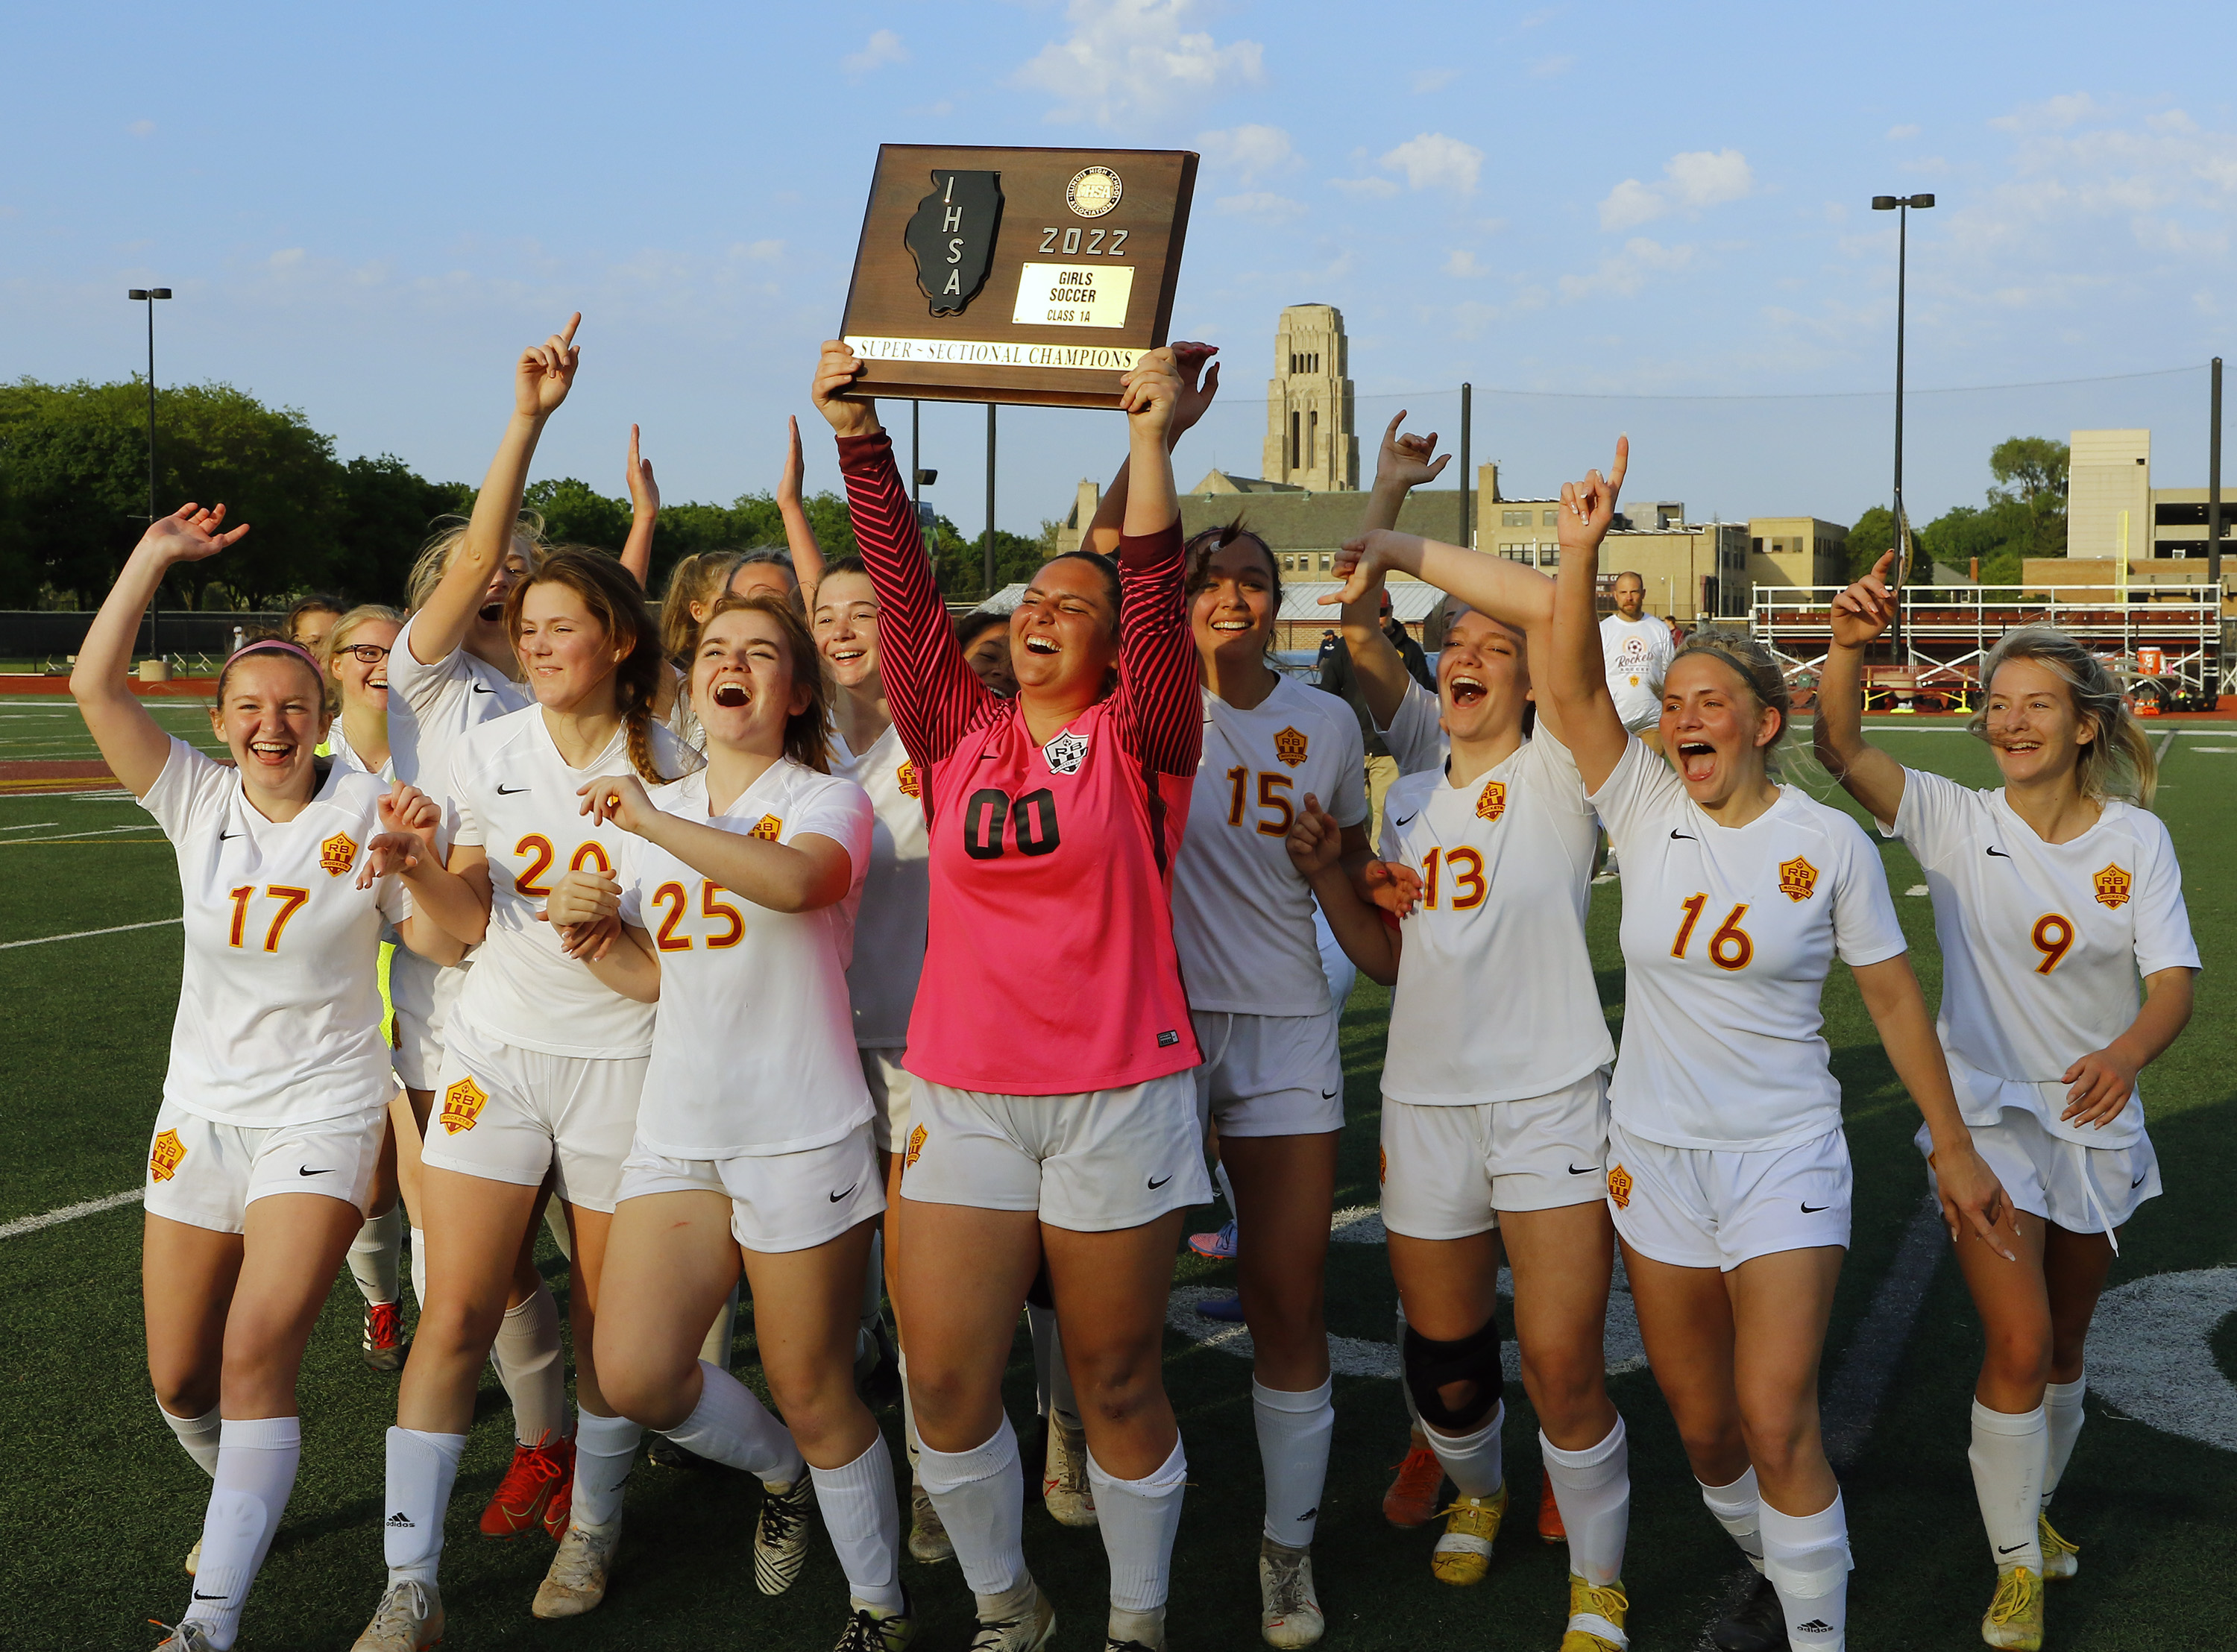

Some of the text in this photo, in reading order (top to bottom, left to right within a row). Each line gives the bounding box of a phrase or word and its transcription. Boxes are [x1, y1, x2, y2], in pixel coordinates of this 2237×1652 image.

[1068, 171, 1087, 197] ILLINOIS
[1108, 173, 1120, 199] SCHOOL
[1069, 201, 1113, 215] ASSOCIATION
[1038, 227, 1130, 256] 2022
[1059, 271, 1094, 286] GIRLS
[1049, 288, 1097, 303] SOCCER
[1047, 309, 1091, 322] CLASS 1A
[1028, 347, 1133, 368] CHAMPIONS
[1055, 742, 1083, 757] RB
[1282, 738, 1300, 746] RB
[1227, 765, 1294, 838] 15
[1481, 788, 1499, 801] RB
[752, 822, 773, 831] RB
[964, 787, 1060, 860] 00
[329, 844, 350, 854] RB
[1421, 845, 1488, 911] 13
[1788, 868, 1810, 879] RB
[2102, 877, 2124, 885] RB
[228, 884, 310, 953] 17
[651, 878, 746, 952] 25
[1670, 892, 1755, 971] 16
[2030, 912, 2075, 976] 9
[451, 1092, 475, 1106] RB
[442, 1115, 471, 1126] ROCKETS
[157, 1141, 177, 1158] RB
[1612, 1176, 1626, 1187] RB
